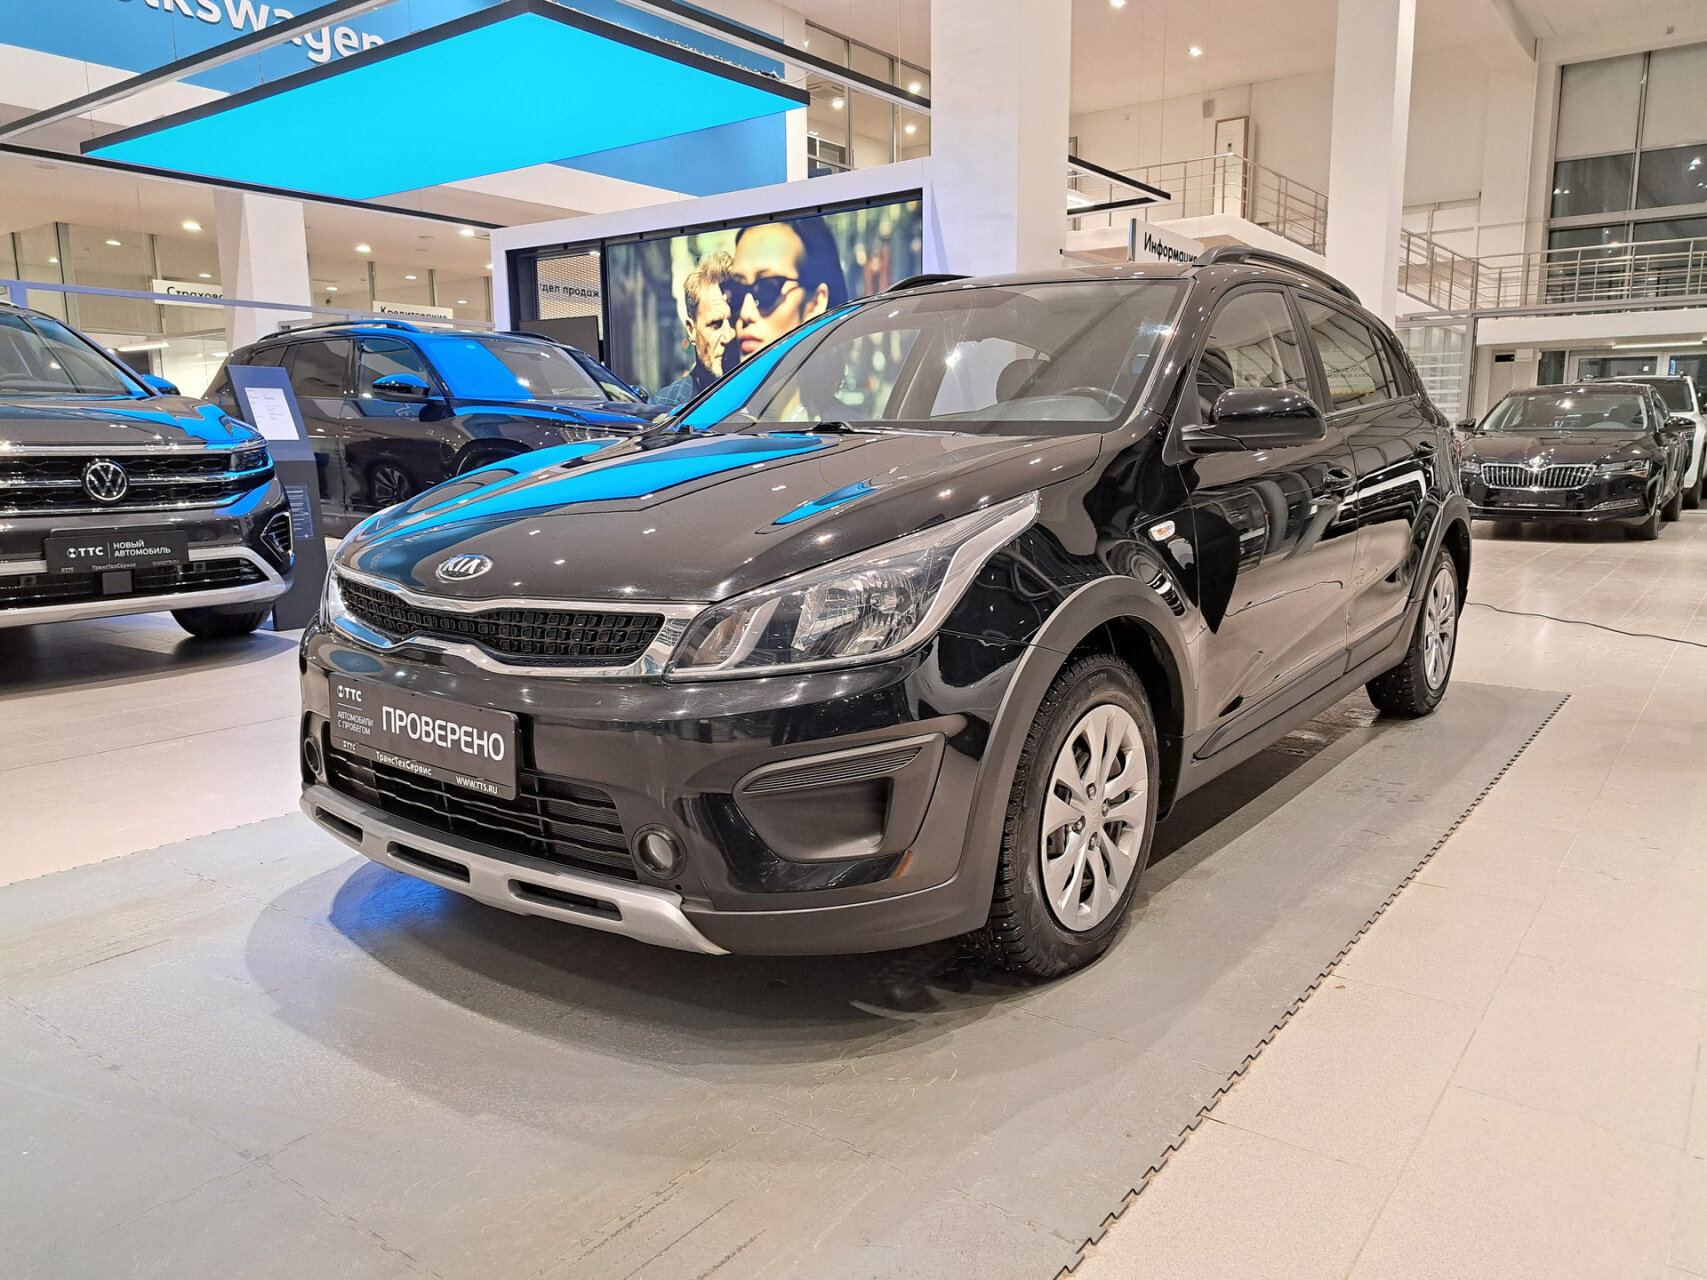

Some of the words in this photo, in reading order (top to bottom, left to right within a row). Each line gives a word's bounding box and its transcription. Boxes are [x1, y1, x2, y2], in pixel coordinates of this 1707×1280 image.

[540, 283, 560, 293] дел
[78, 547, 104, 557] ТТС
[113, 540, 145, 549] НОВЫЙ
[114, 547, 171, 558] АВТОМОБИЛЬ
[344, 687, 362, 703] ТТС
[337, 710, 374, 728] АВТОМОБИЛИ
[342, 720, 371, 736] ПРОБЕГОМ
[382, 705, 505, 762] ПРОВЕРЕНО
[375, 750, 433, 776] ТрансТехСервис
[456, 776, 499, 795] WWW.TTS.RU
